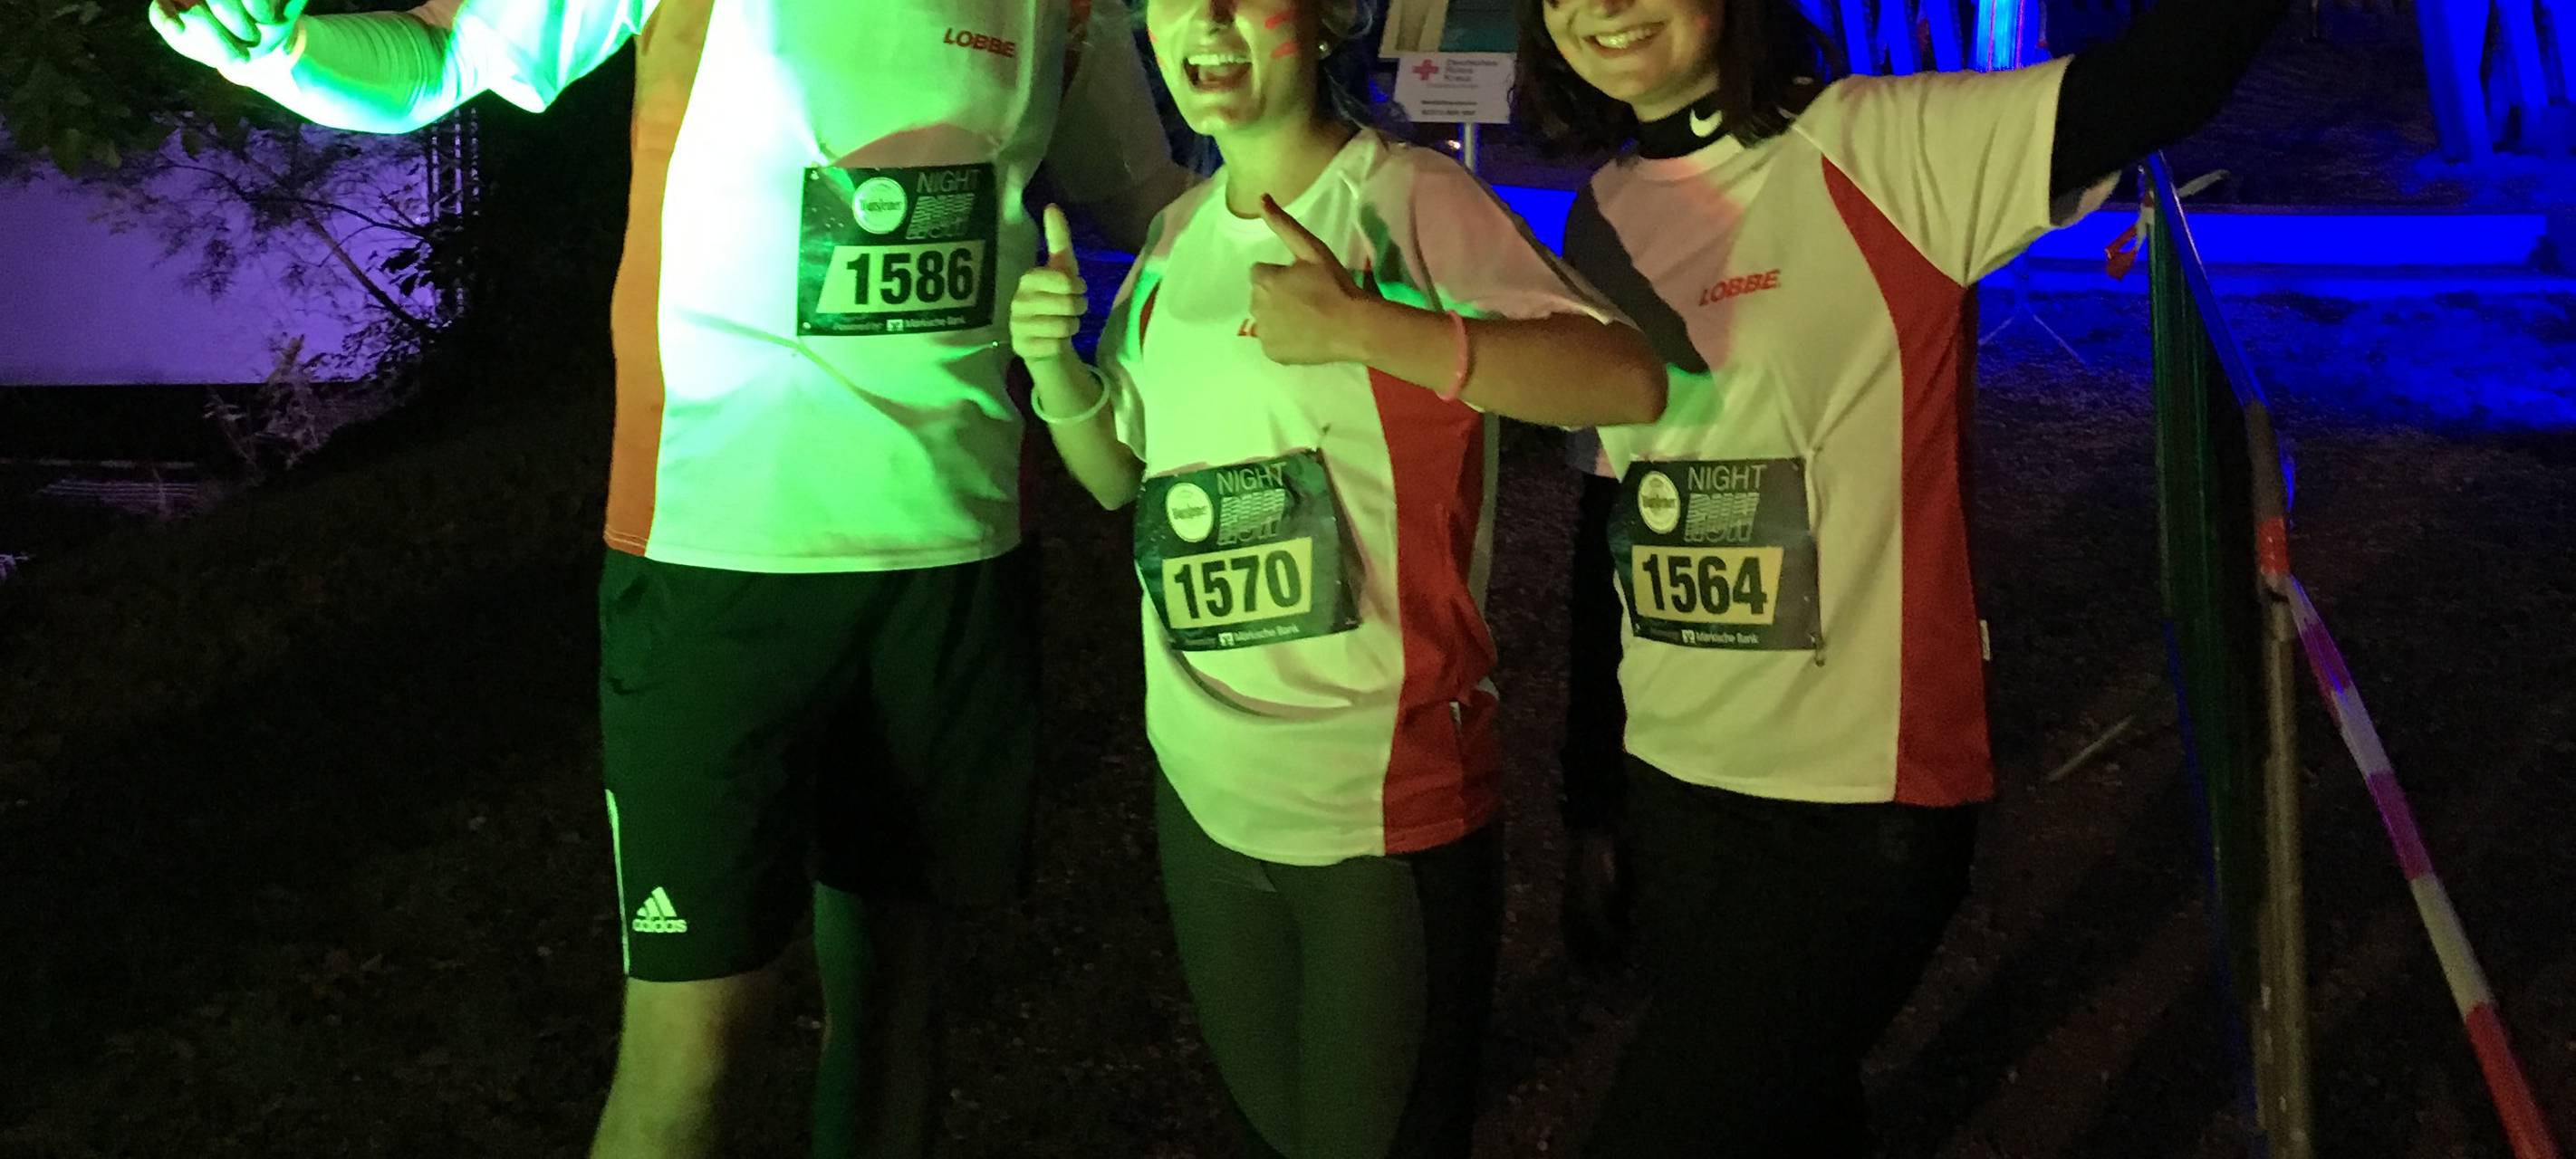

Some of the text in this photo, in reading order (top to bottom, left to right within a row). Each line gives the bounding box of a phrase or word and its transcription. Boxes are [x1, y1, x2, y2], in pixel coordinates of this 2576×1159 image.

[943, 27, 1016, 59] LOBBE
[916, 168, 980, 194] NIGHT
[846, 247, 975, 305] 1586
[1698, 268, 1781, 307] LOBBE
[1216, 462, 1287, 494] NIGHT
[1687, 464, 1767, 492] NIGHT
[1173, 550, 1302, 619] 1570
[1641, 553, 1769, 616] 1564
[632, 918, 687, 934] adidas
